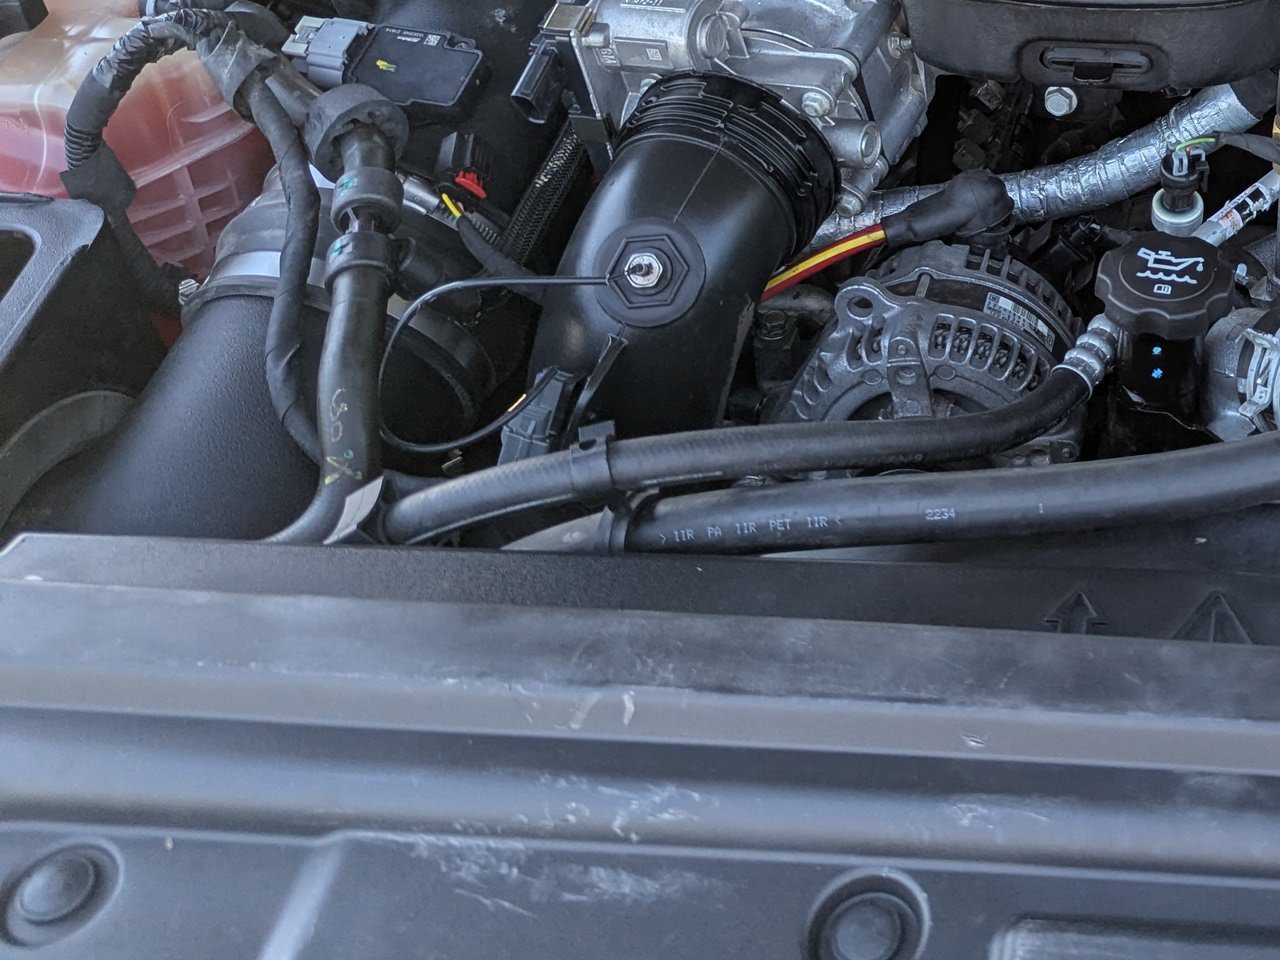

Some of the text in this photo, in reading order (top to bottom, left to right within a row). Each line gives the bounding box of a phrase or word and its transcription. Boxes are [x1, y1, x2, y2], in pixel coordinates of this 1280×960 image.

[925, 508, 955, 520] 2234
[673, 529, 695, 542] IIR
[708, 526, 722, 538] PA
[735, 522, 758, 535] IIR
[769, 519, 791, 531] PET
[807, 516, 828, 528] IIR
